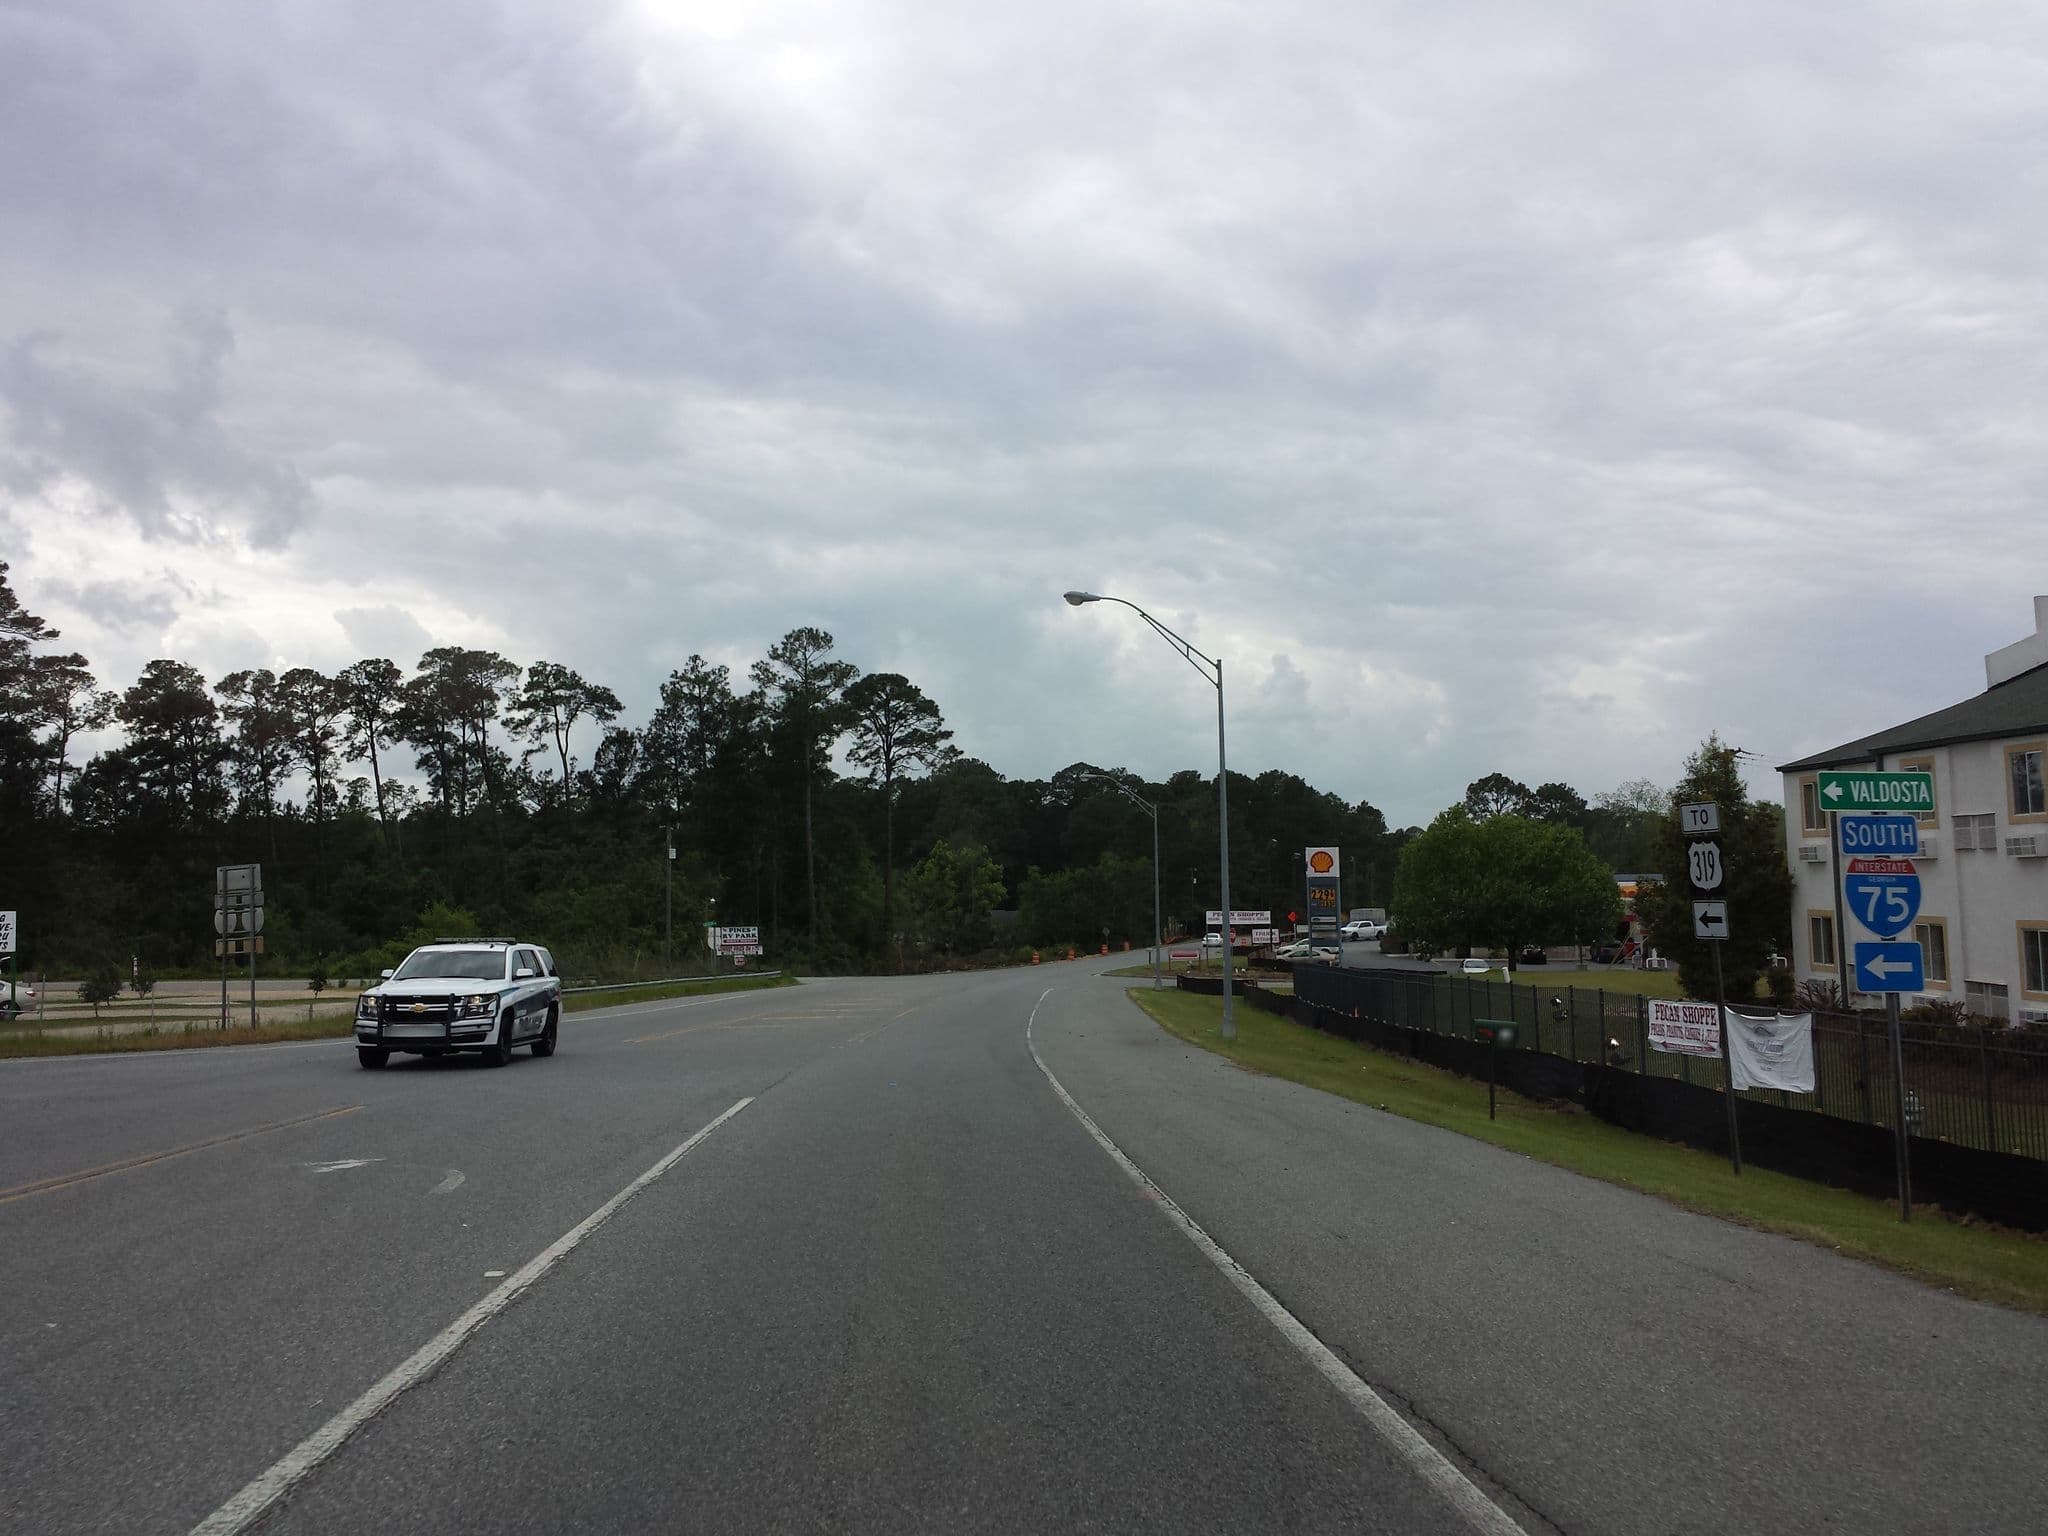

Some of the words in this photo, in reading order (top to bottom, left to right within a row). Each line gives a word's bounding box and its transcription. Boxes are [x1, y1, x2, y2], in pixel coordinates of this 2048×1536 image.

[1849, 780, 1931, 803] VALDOSTA
[1690, 809, 1709, 825] TO
[1845, 821, 1915, 846] SOUTH
[1693, 850, 1715, 882] 319
[1854, 862, 1908, 873] INTERSTATE
[1857, 886, 1910, 923] 75
[1654, 1003, 1680, 1023] PECAN
[1681, 1005, 1717, 1026] SHOPPE
